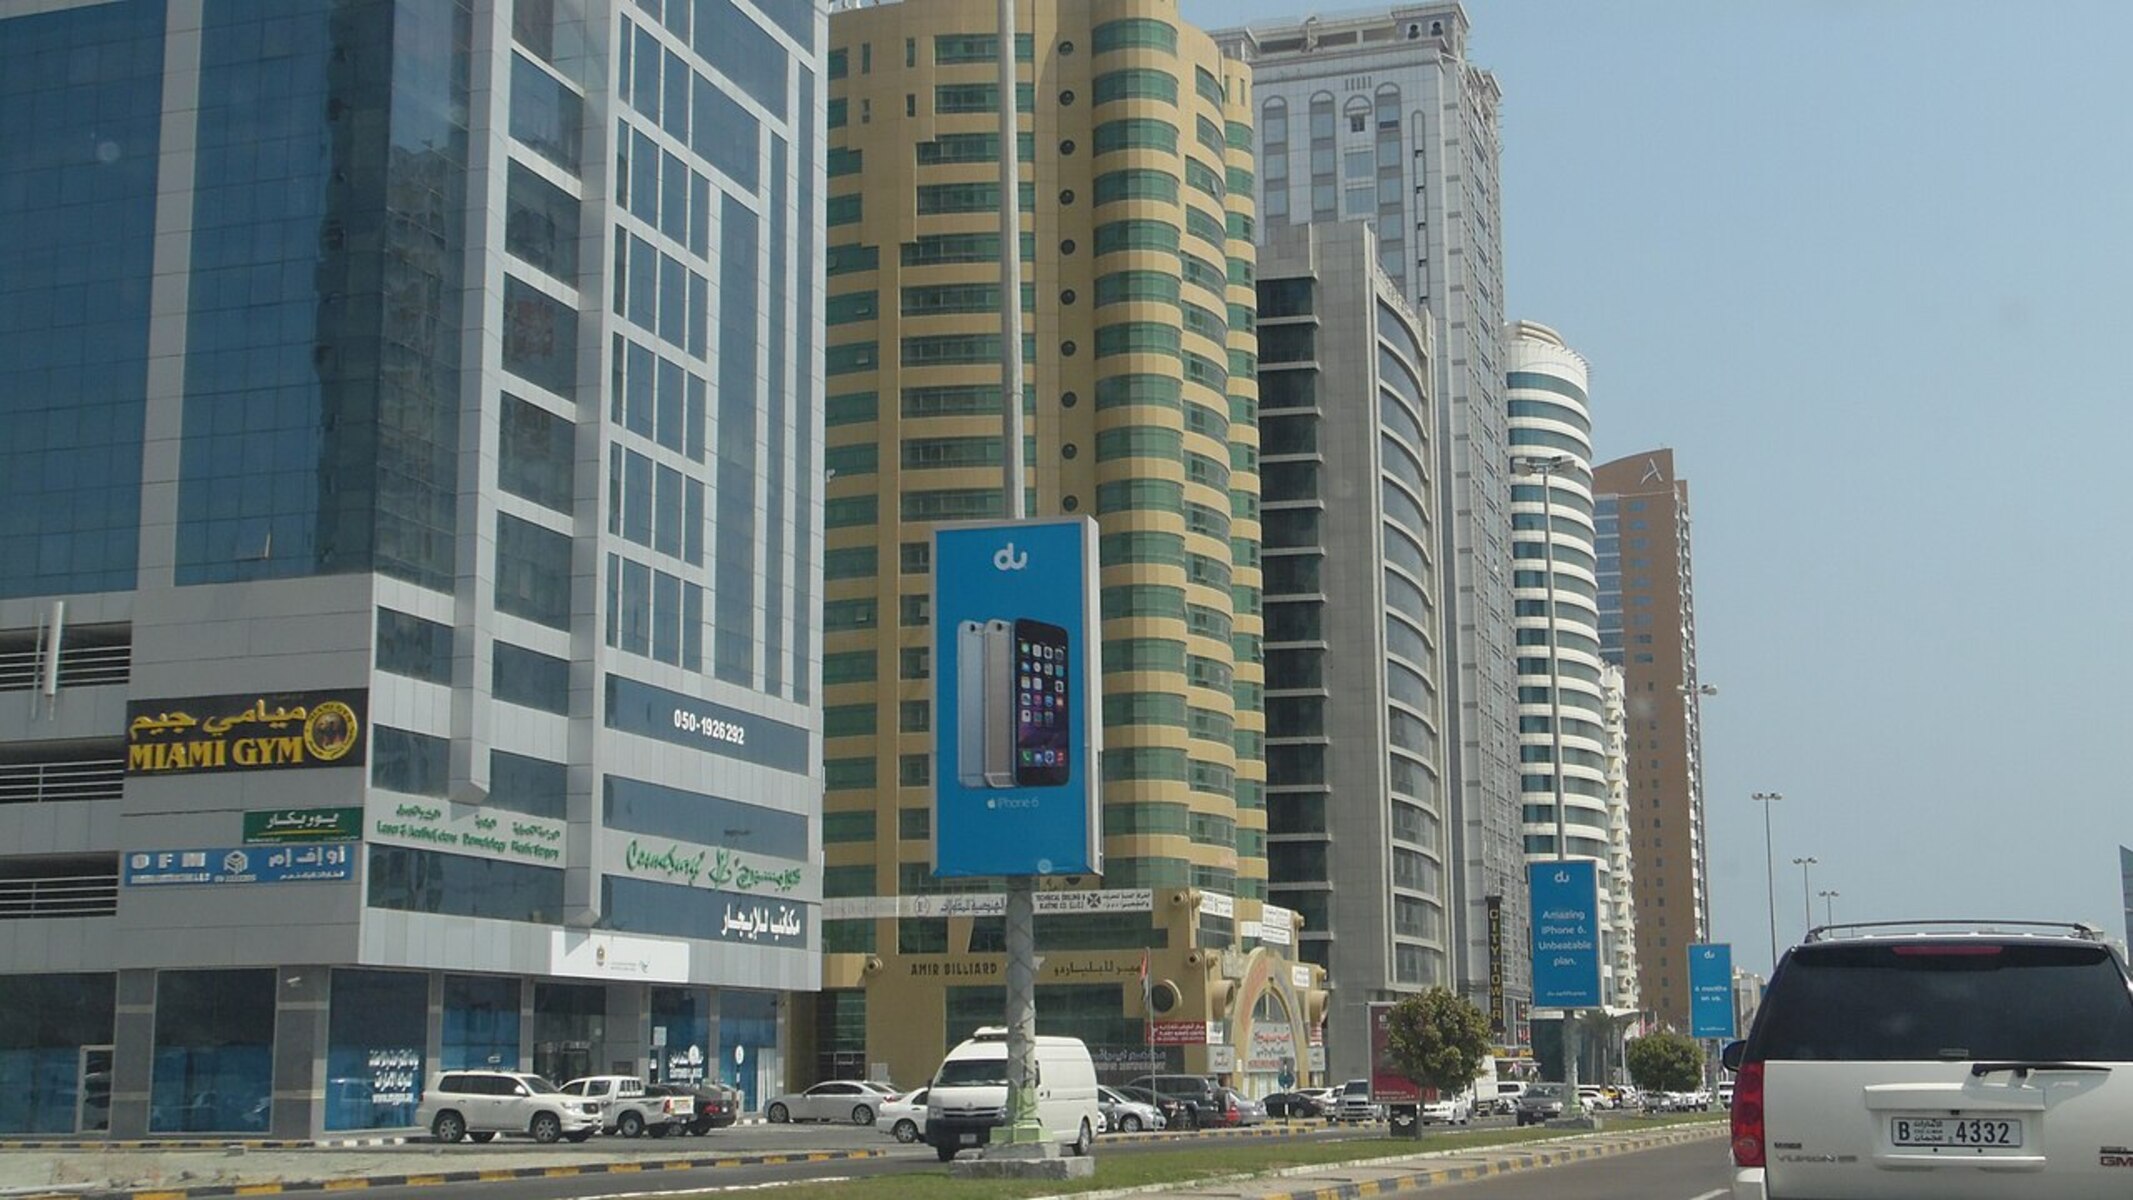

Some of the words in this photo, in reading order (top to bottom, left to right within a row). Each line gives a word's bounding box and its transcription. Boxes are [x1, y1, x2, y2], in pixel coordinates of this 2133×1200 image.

[994, 542, 1029, 571] du
[202, 699, 306, 737] ميامي
[674, 709, 744, 745] 050-1926292
[128, 739, 226, 771] MIAMI
[232, 736, 304, 765] GYM
[997, 797, 1031, 809] iPhone
[1031, 797, 1040, 809] 6
[1554, 871, 1570, 882] du
[721, 903, 769, 940] للإيجار
[770, 905, 800, 940] مكاتب
[1542, 910, 1586, 921] Amazing
[1490, 909, 1500, 957] CITY
[1541, 924, 1575, 935] iPhone
[1538, 940, 1592, 950] Unbeatable
[1704, 950, 1716, 959] du
[911, 963, 939, 976] AMIR
[944, 962, 998, 976] BILLIARD
[1553, 956, 1577, 967] plan.
[1492, 961, 1503, 1020] TOWER
[1898, 1121, 1911, 1141] B
[1955, 1121, 2011, 1144] 4332
